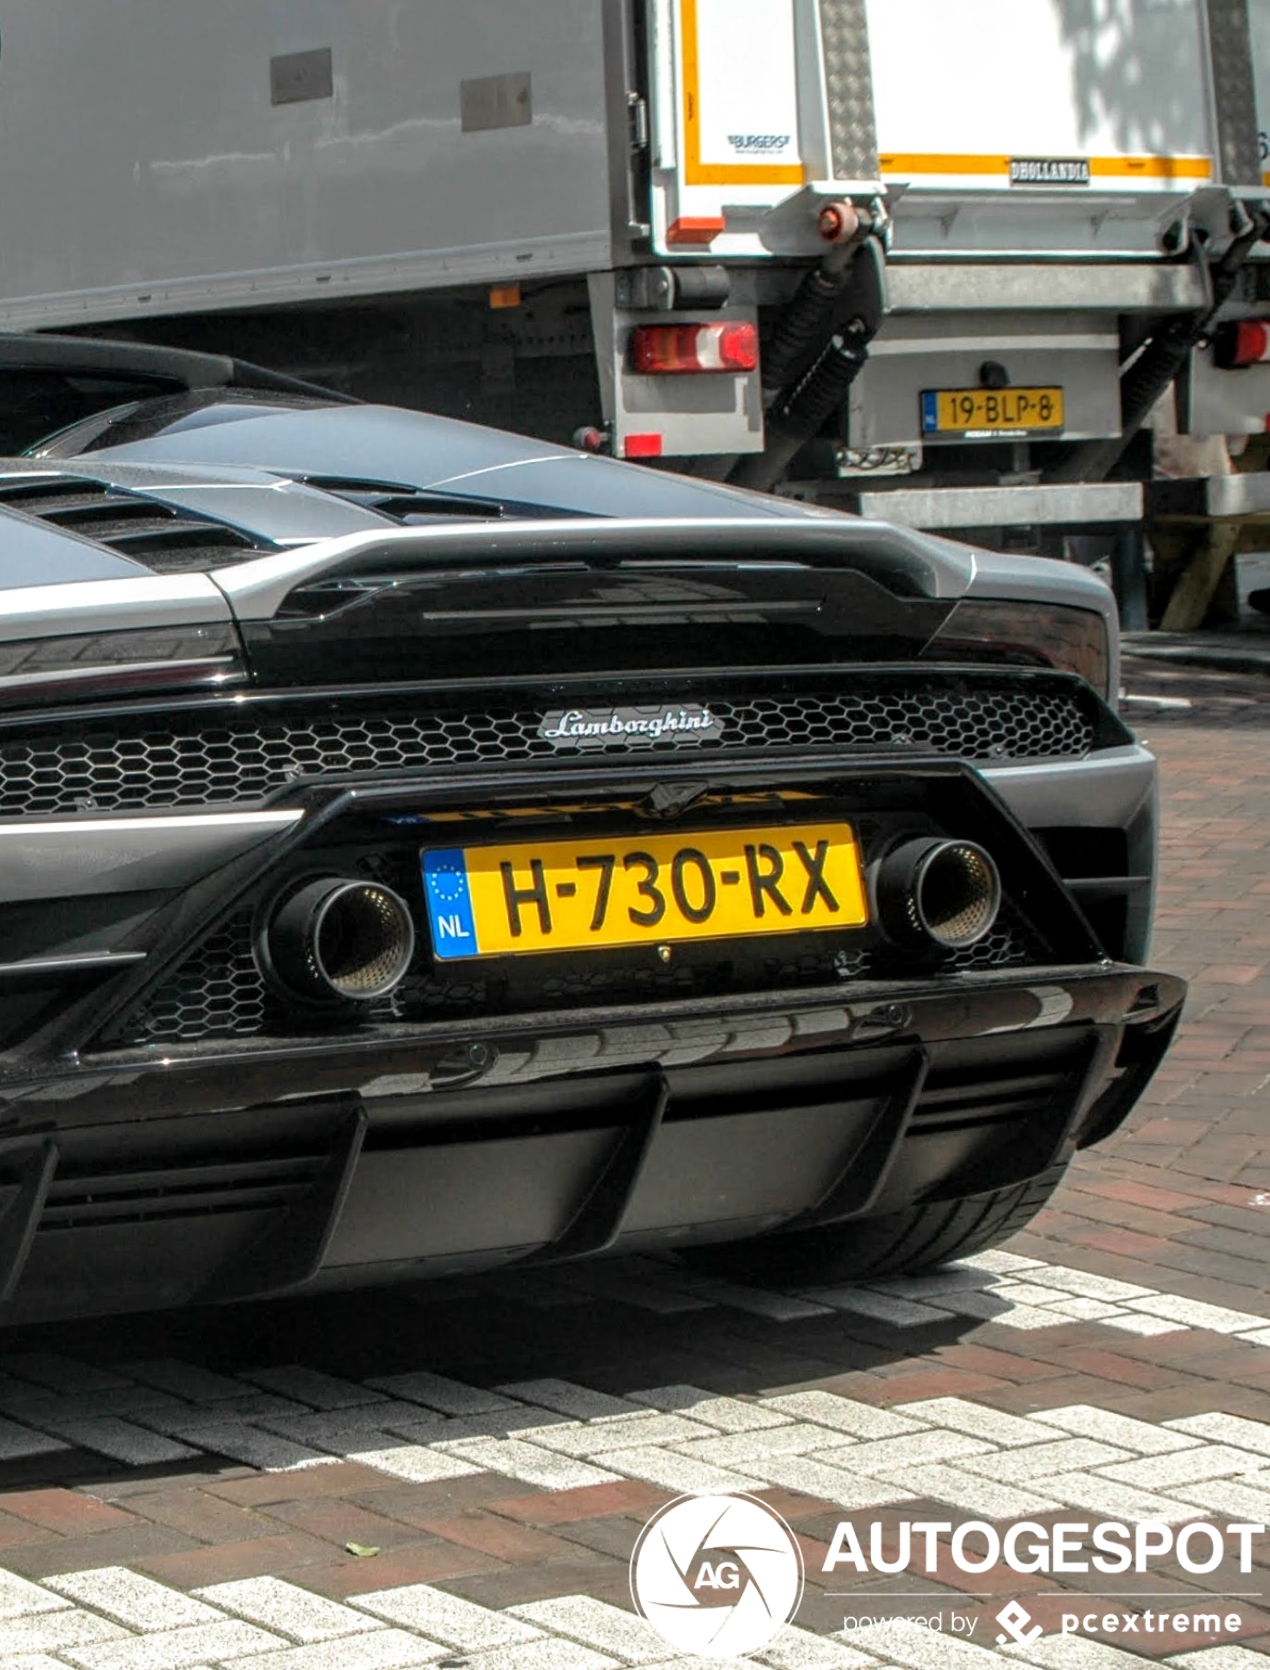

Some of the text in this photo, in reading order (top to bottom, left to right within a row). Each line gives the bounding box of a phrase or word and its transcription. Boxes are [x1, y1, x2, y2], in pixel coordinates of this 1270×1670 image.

[1011, 161, 1090, 181] DHOLLANDIA
[951, 394, 1054, 424] 19-BLP-8
[545, 709, 713, 738] Lamborghini
[499, 839, 840, 938] H-730-RX
[438, 914, 470, 939] NL
